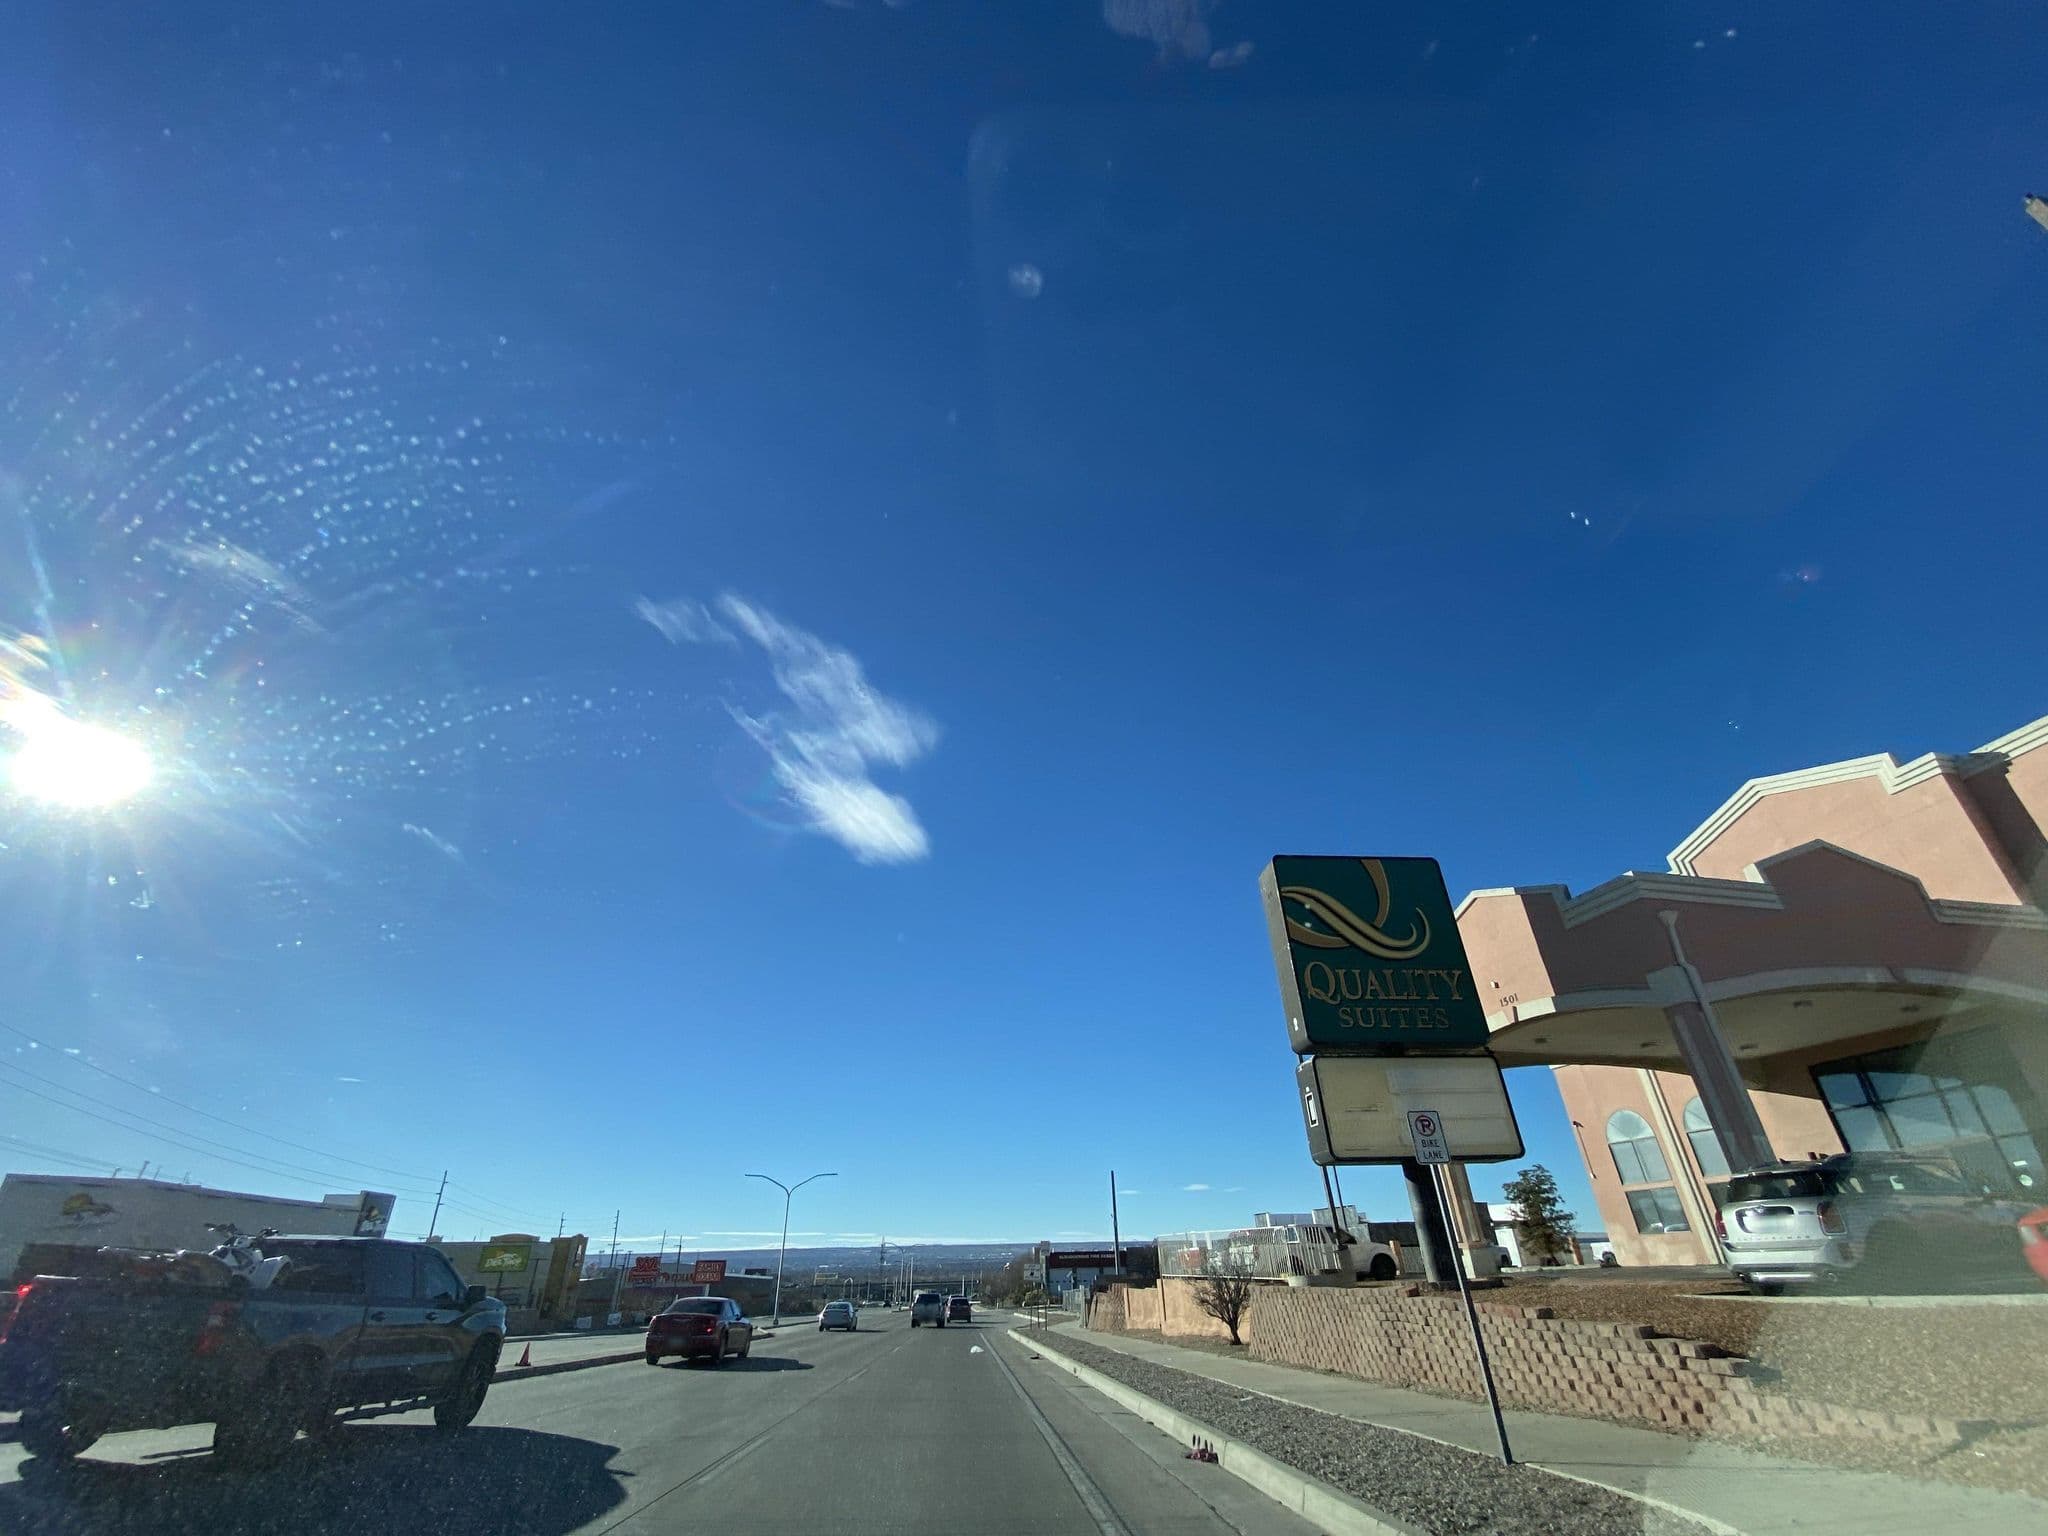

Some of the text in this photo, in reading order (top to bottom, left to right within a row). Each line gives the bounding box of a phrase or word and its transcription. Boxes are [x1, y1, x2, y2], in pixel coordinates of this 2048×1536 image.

[1303, 961, 1463, 1005] QUALITY
[1499, 992, 1519, 1008] 1501
[1340, 1006, 1450, 1030] SUITES
[1421, 1139, 1440, 1148] BIKE
[1423, 1150, 1444, 1160] LANE
